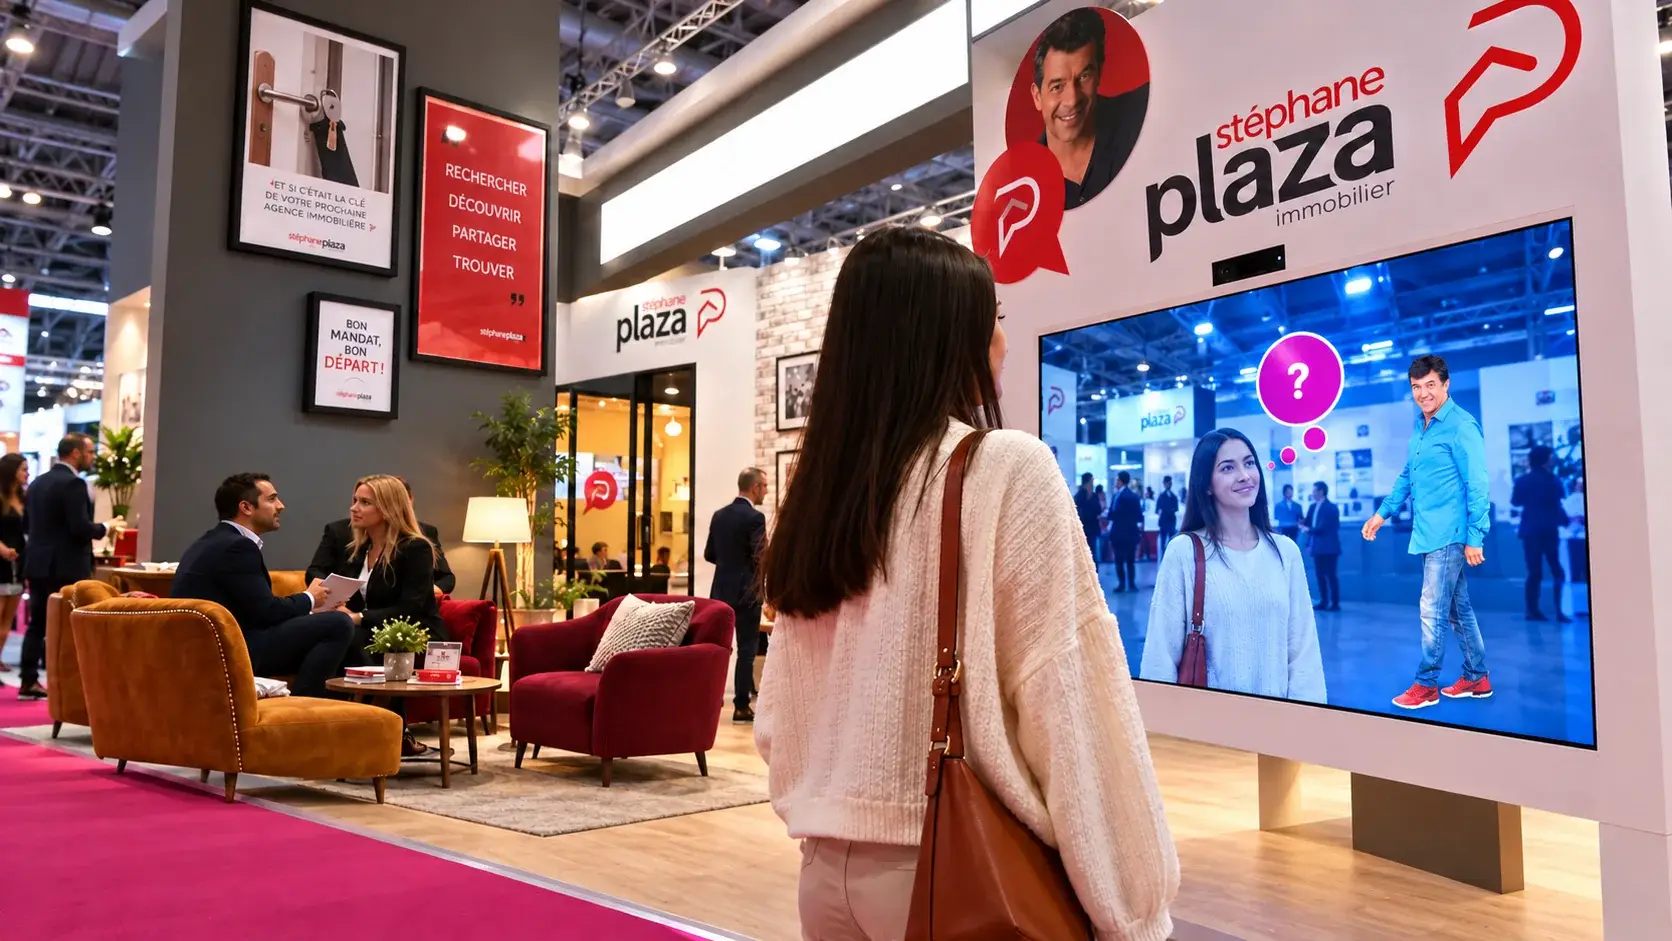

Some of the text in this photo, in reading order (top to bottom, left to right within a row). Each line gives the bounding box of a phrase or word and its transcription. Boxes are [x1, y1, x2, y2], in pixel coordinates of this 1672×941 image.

[1216, 66, 1385, 149] stéphane
[445, 162, 527, 197] RECHERCHER
[1145, 104, 1395, 263] plaza
[265, 191, 367, 219] DE VOTRE PROCHAINE
[288, 183, 297, 193] SI
[299, 186, 332, 200] C'ÉTAIT
[335, 194, 346, 204] LA
[348, 198, 366, 208] CLÉ
[448, 193, 522, 224] DÉCOUVRIR
[1276, 180, 1395, 227] immobilier
[263, 203, 366, 230] AGENCE IMMOBILIÈRE
[452, 224, 517, 252] PARTAGER
[453, 254, 515, 280] TROUVER
[330, 329, 382, 348] MANDAT,
[346, 319, 368, 330] BON
[616, 304, 687, 353] plaza
[344, 345, 367, 357] BON
[1141, 412, 1171, 432] plaza
